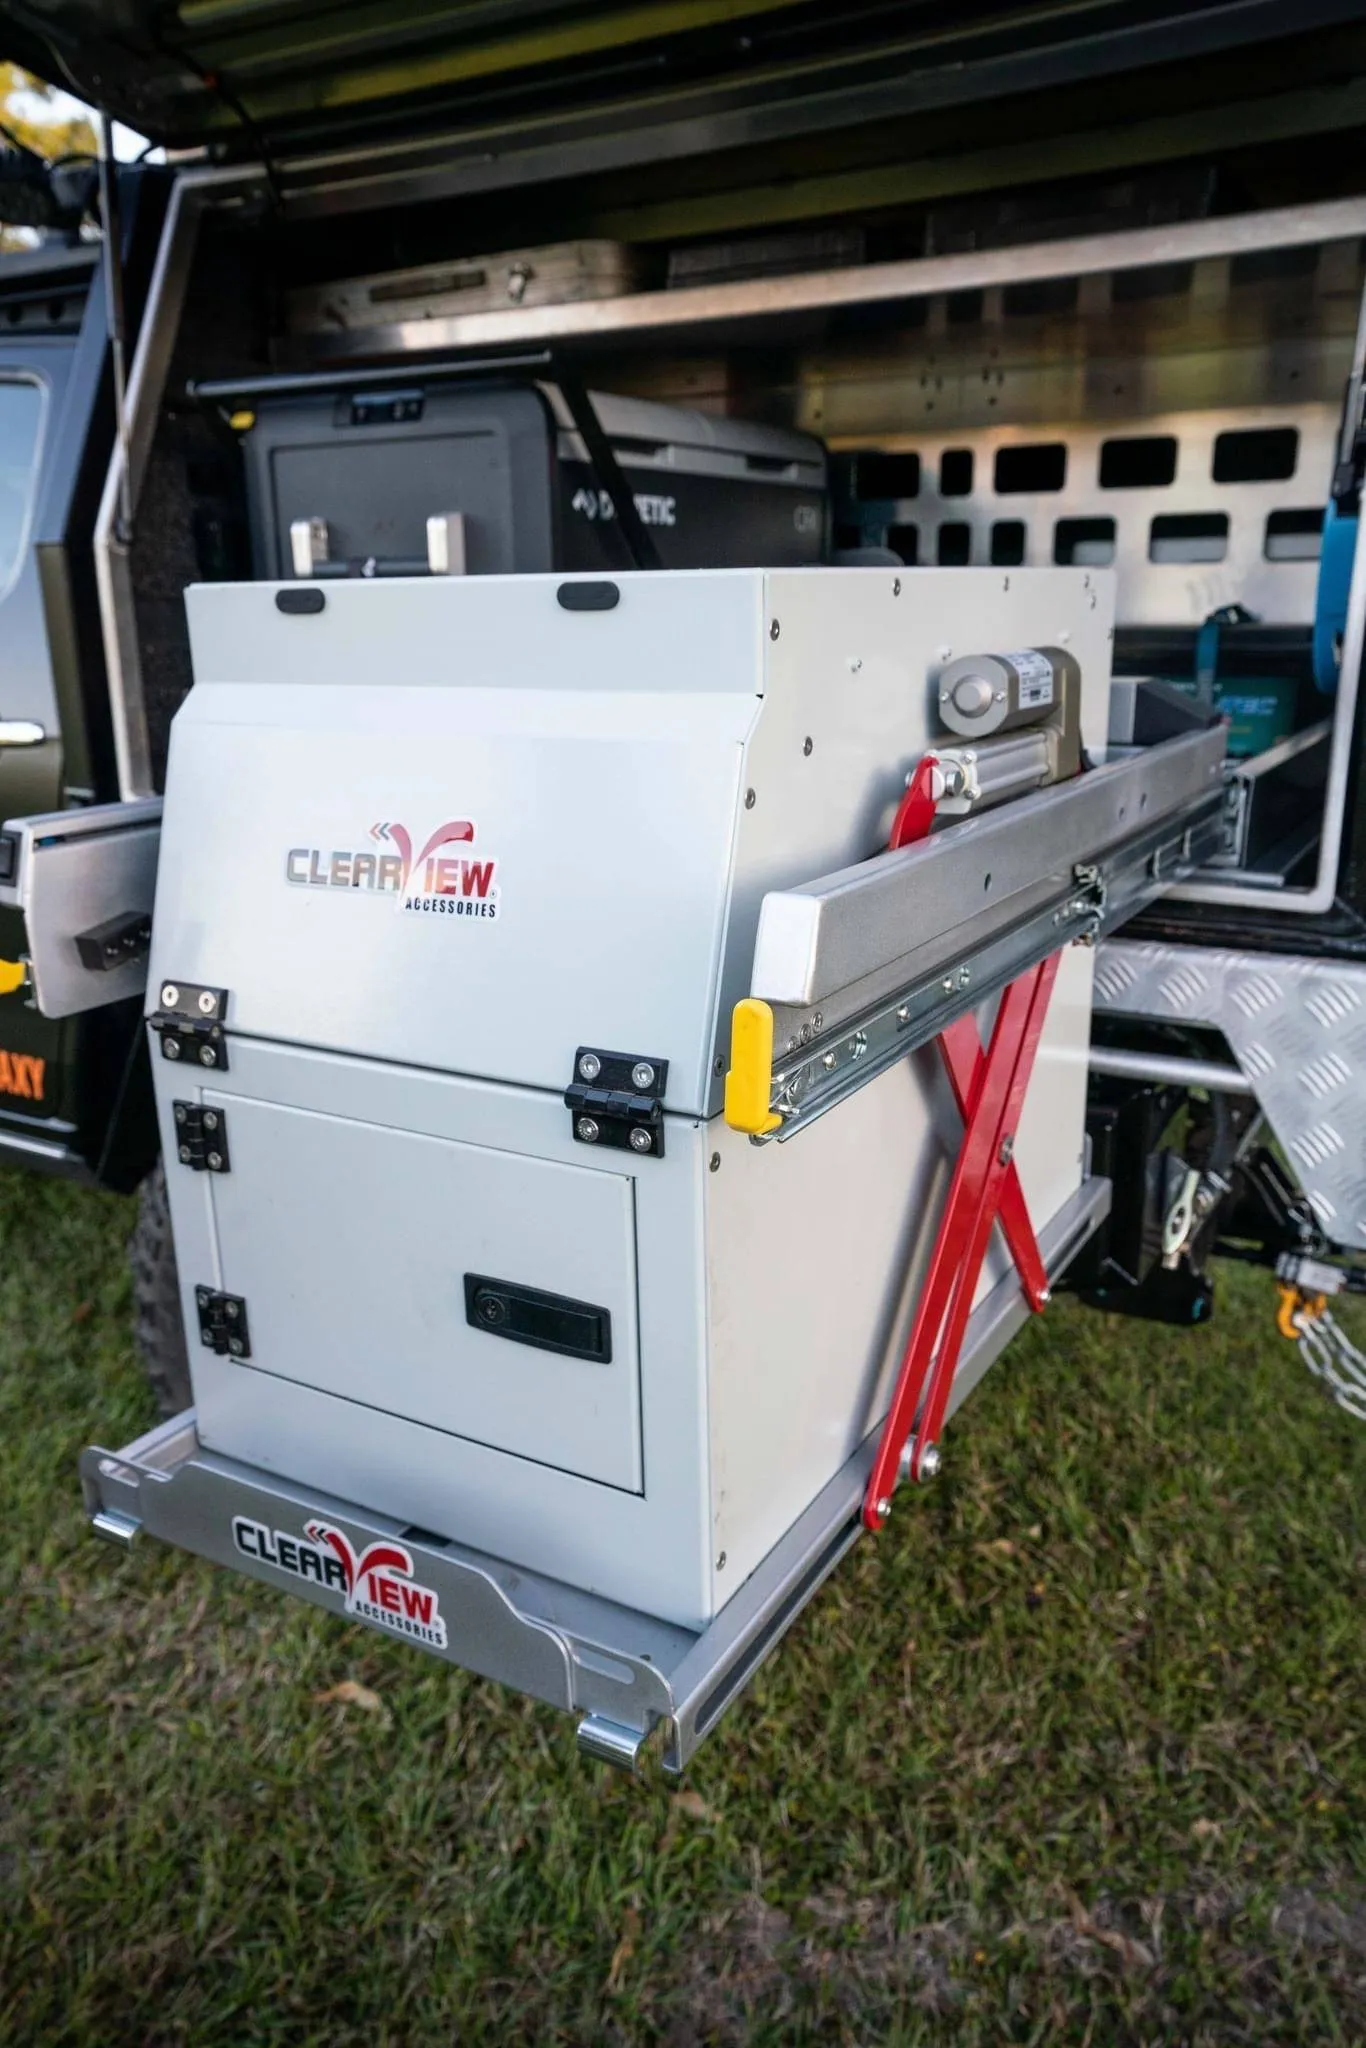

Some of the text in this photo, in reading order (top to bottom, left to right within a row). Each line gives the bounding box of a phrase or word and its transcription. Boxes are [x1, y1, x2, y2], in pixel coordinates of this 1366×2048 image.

[286, 820, 495, 898] CLEARVIEW
[404, 897, 496, 919] ACCESSORIES
[235, 1521, 433, 1626] CLEARVIEW
[355, 1600, 443, 1646] ACCESSORIES
